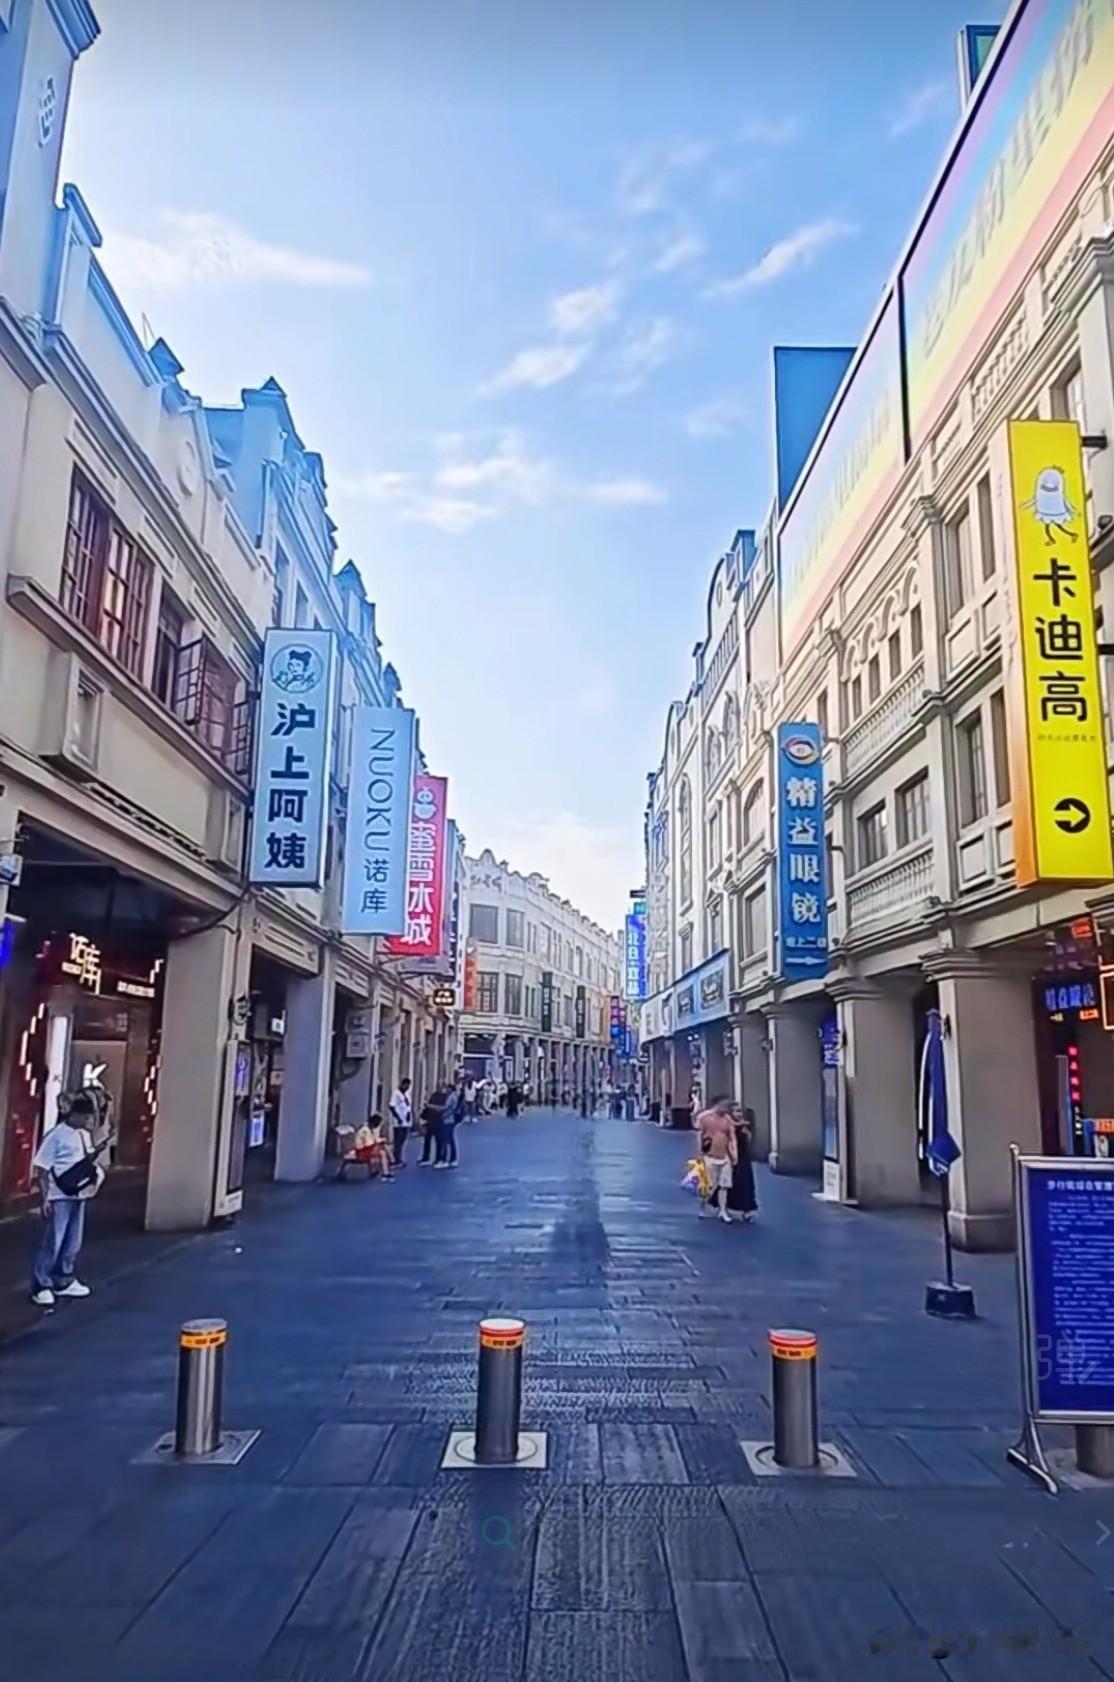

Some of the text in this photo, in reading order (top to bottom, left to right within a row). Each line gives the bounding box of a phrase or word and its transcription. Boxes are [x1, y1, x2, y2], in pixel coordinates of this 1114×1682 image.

[1033, 557, 1088, 723] 卡迪高
[266, 702, 316, 869] 沪上阿姨
[360, 729, 396, 914] NUOKU 诺库
[786, 776, 823, 923] 精益眼镜
